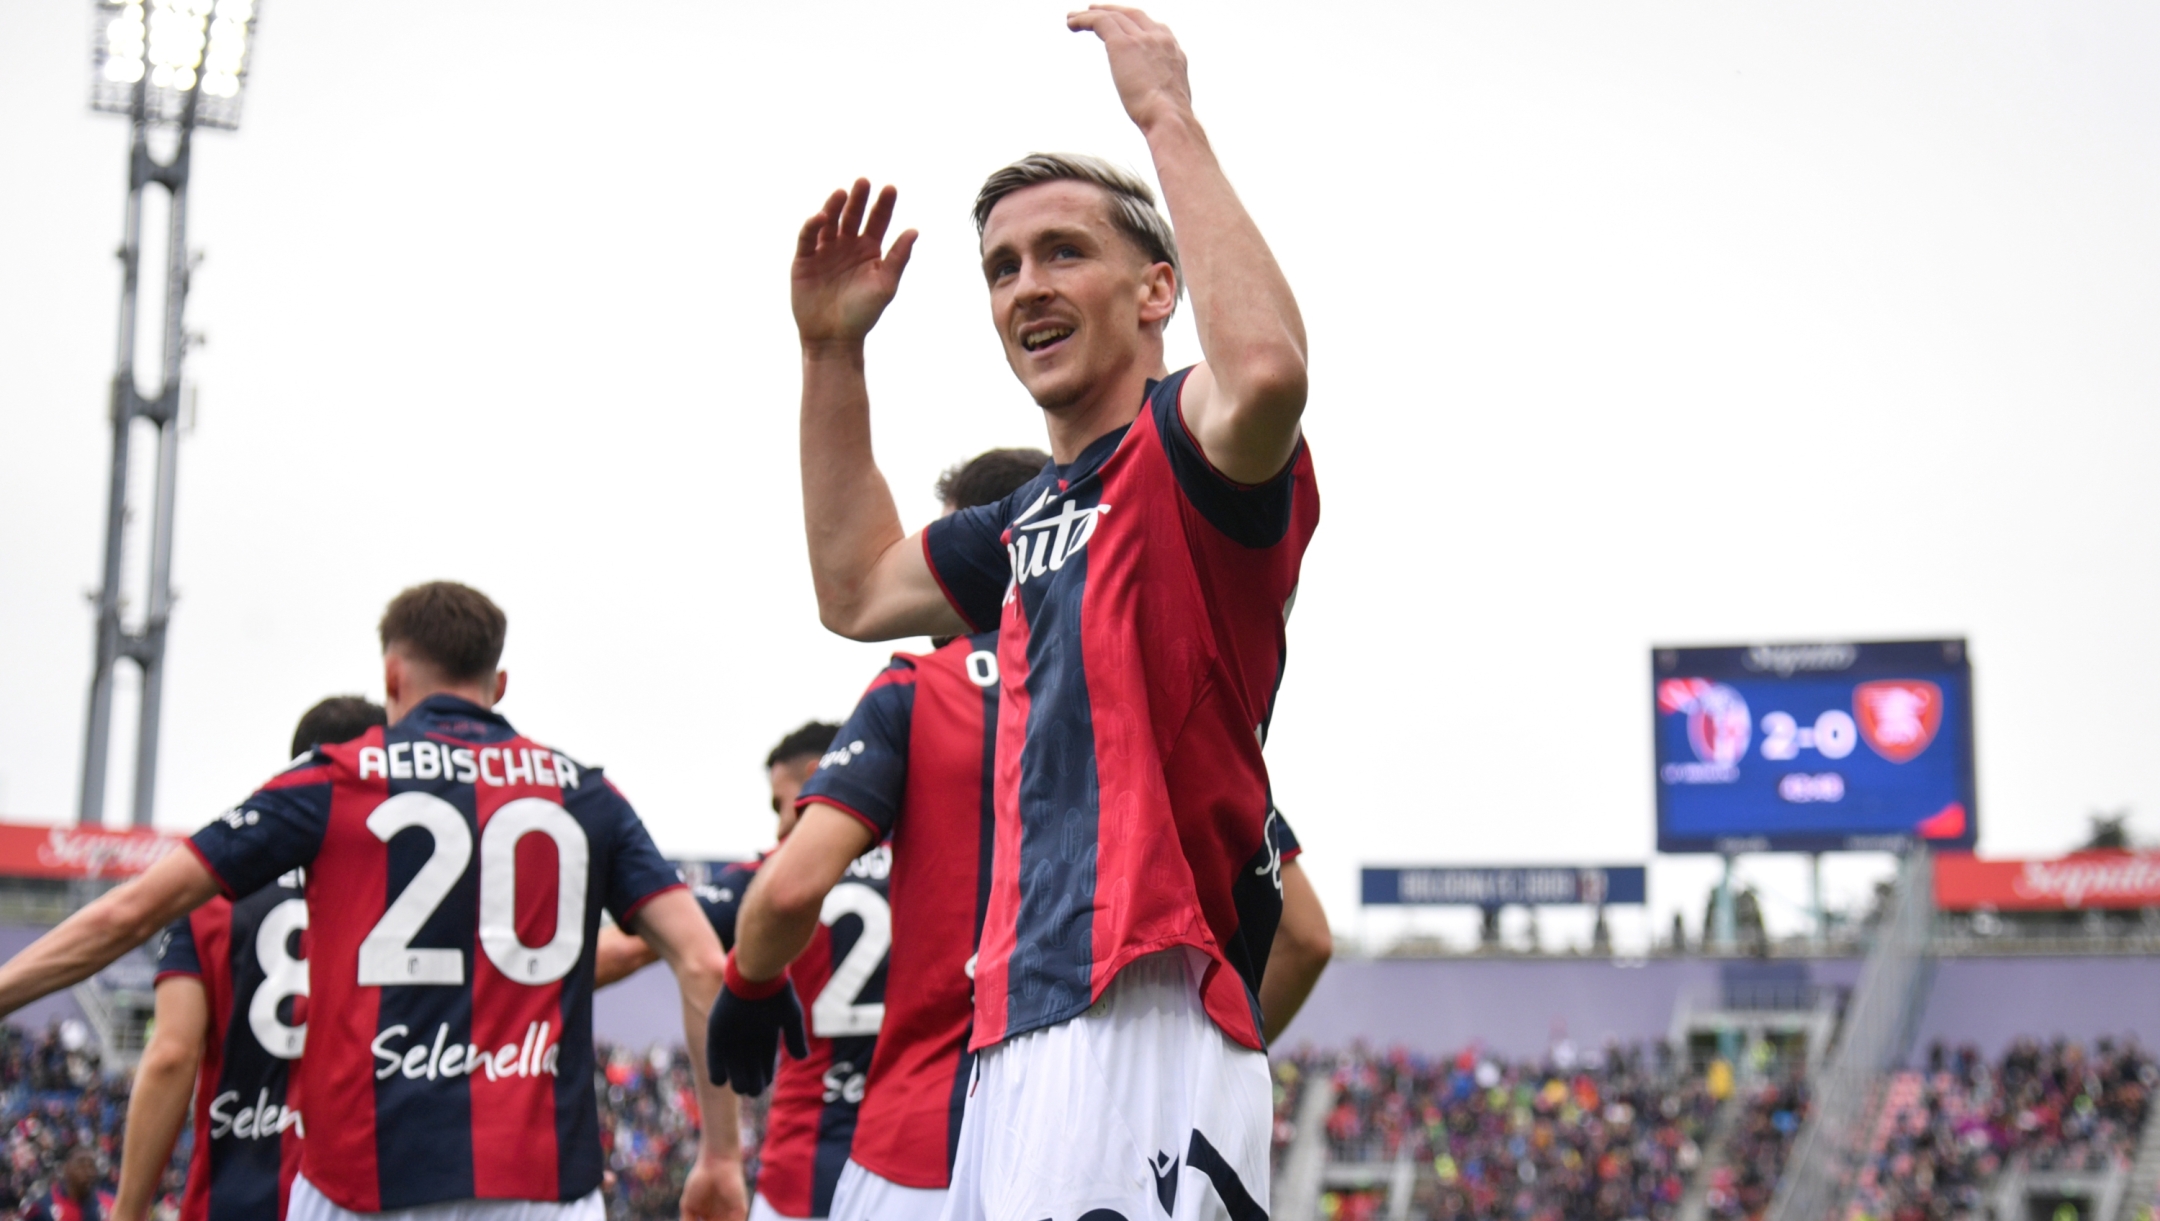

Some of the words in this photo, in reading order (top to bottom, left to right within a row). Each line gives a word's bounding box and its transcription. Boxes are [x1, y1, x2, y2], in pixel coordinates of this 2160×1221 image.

[359, 741, 580, 789] AEBISCHER
[357, 791, 590, 987] 20
[248, 898, 310, 1060] 8
[370, 1021, 559, 1083] Selenella
